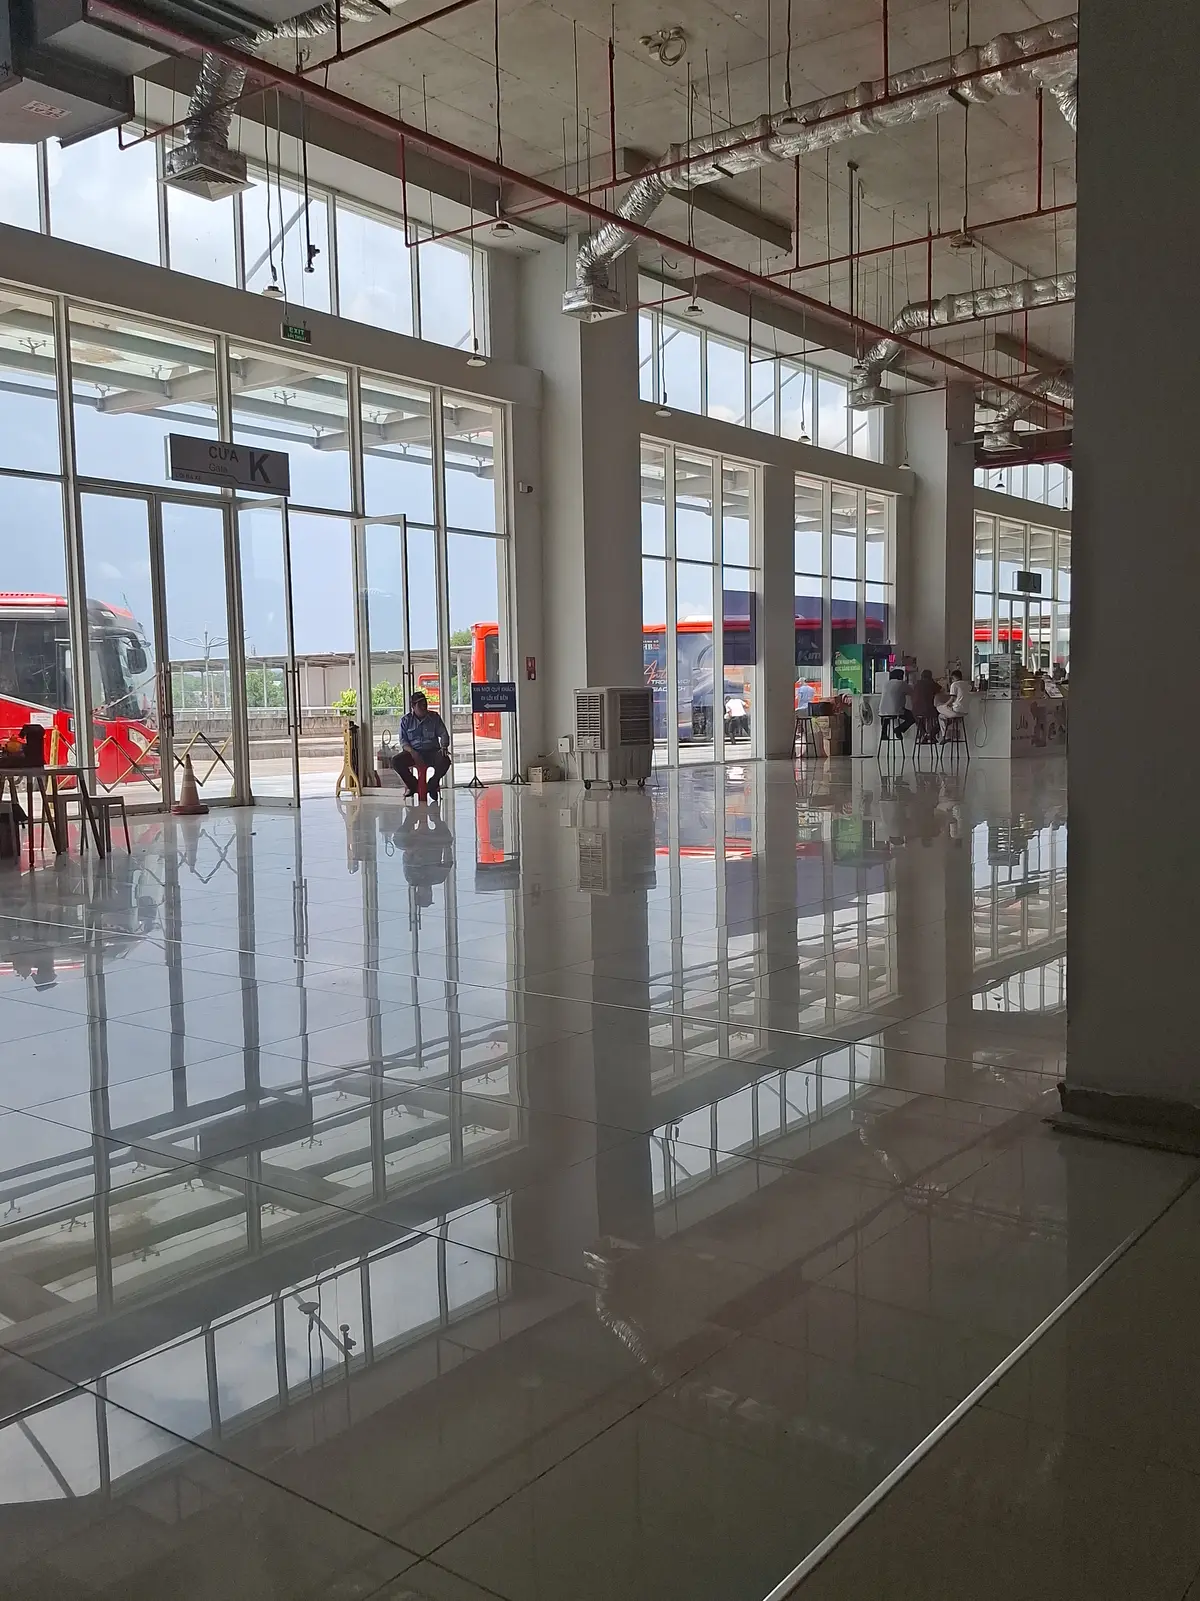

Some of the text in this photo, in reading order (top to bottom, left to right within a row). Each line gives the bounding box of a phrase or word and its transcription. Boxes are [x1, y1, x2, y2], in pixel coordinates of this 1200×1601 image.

[288, 326, 304, 335] EXIT
[208, 444, 239, 463] CỬA
[249, 451, 272, 484] K
